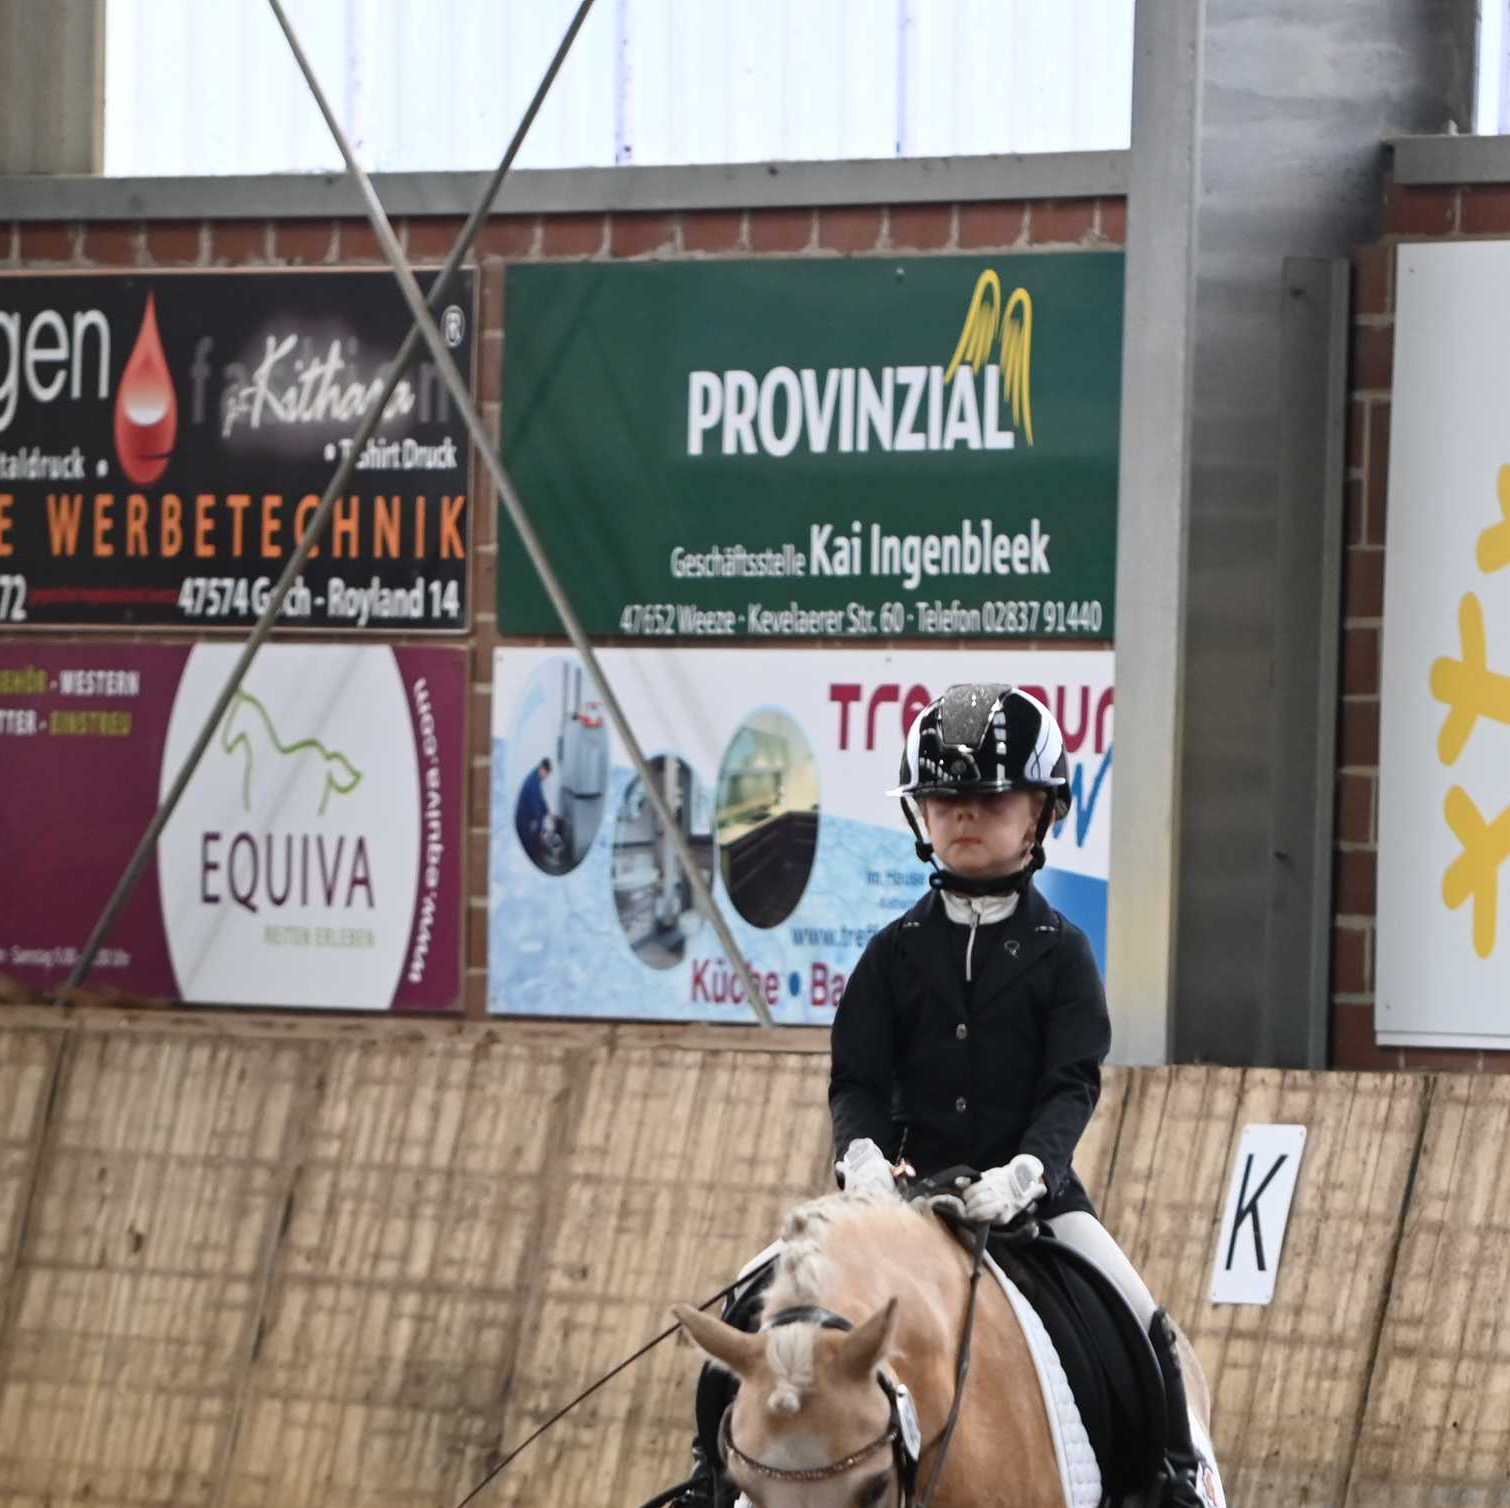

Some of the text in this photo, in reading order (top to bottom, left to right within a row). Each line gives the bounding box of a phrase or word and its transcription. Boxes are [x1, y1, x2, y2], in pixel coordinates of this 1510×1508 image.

[686, 365, 1014, 457] PROVINZIAL
[402, 436, 458, 470] Druck
[46, 493, 467, 559] WERBETECHNIK
[670, 518, 1051, 590] Geschäftsstelle Kai Ingenbleek
[178, 576, 460, 628] 47574 Gch Royland 14
[619, 603, 676, 634] 47652
[676, 603, 737, 634] Weeze
[747, 600, 845, 633] Kevelaerer
[879, 601, 906, 633] 60
[915, 600, 981, 633] Telefon
[981, 601, 1041, 632] 02837
[1043, 600, 1103, 632] 91440
[59, 669, 140, 697] WESTERN
[201, 831, 376, 914] EQUIVA
[1225, 1153, 1289, 1271] K
